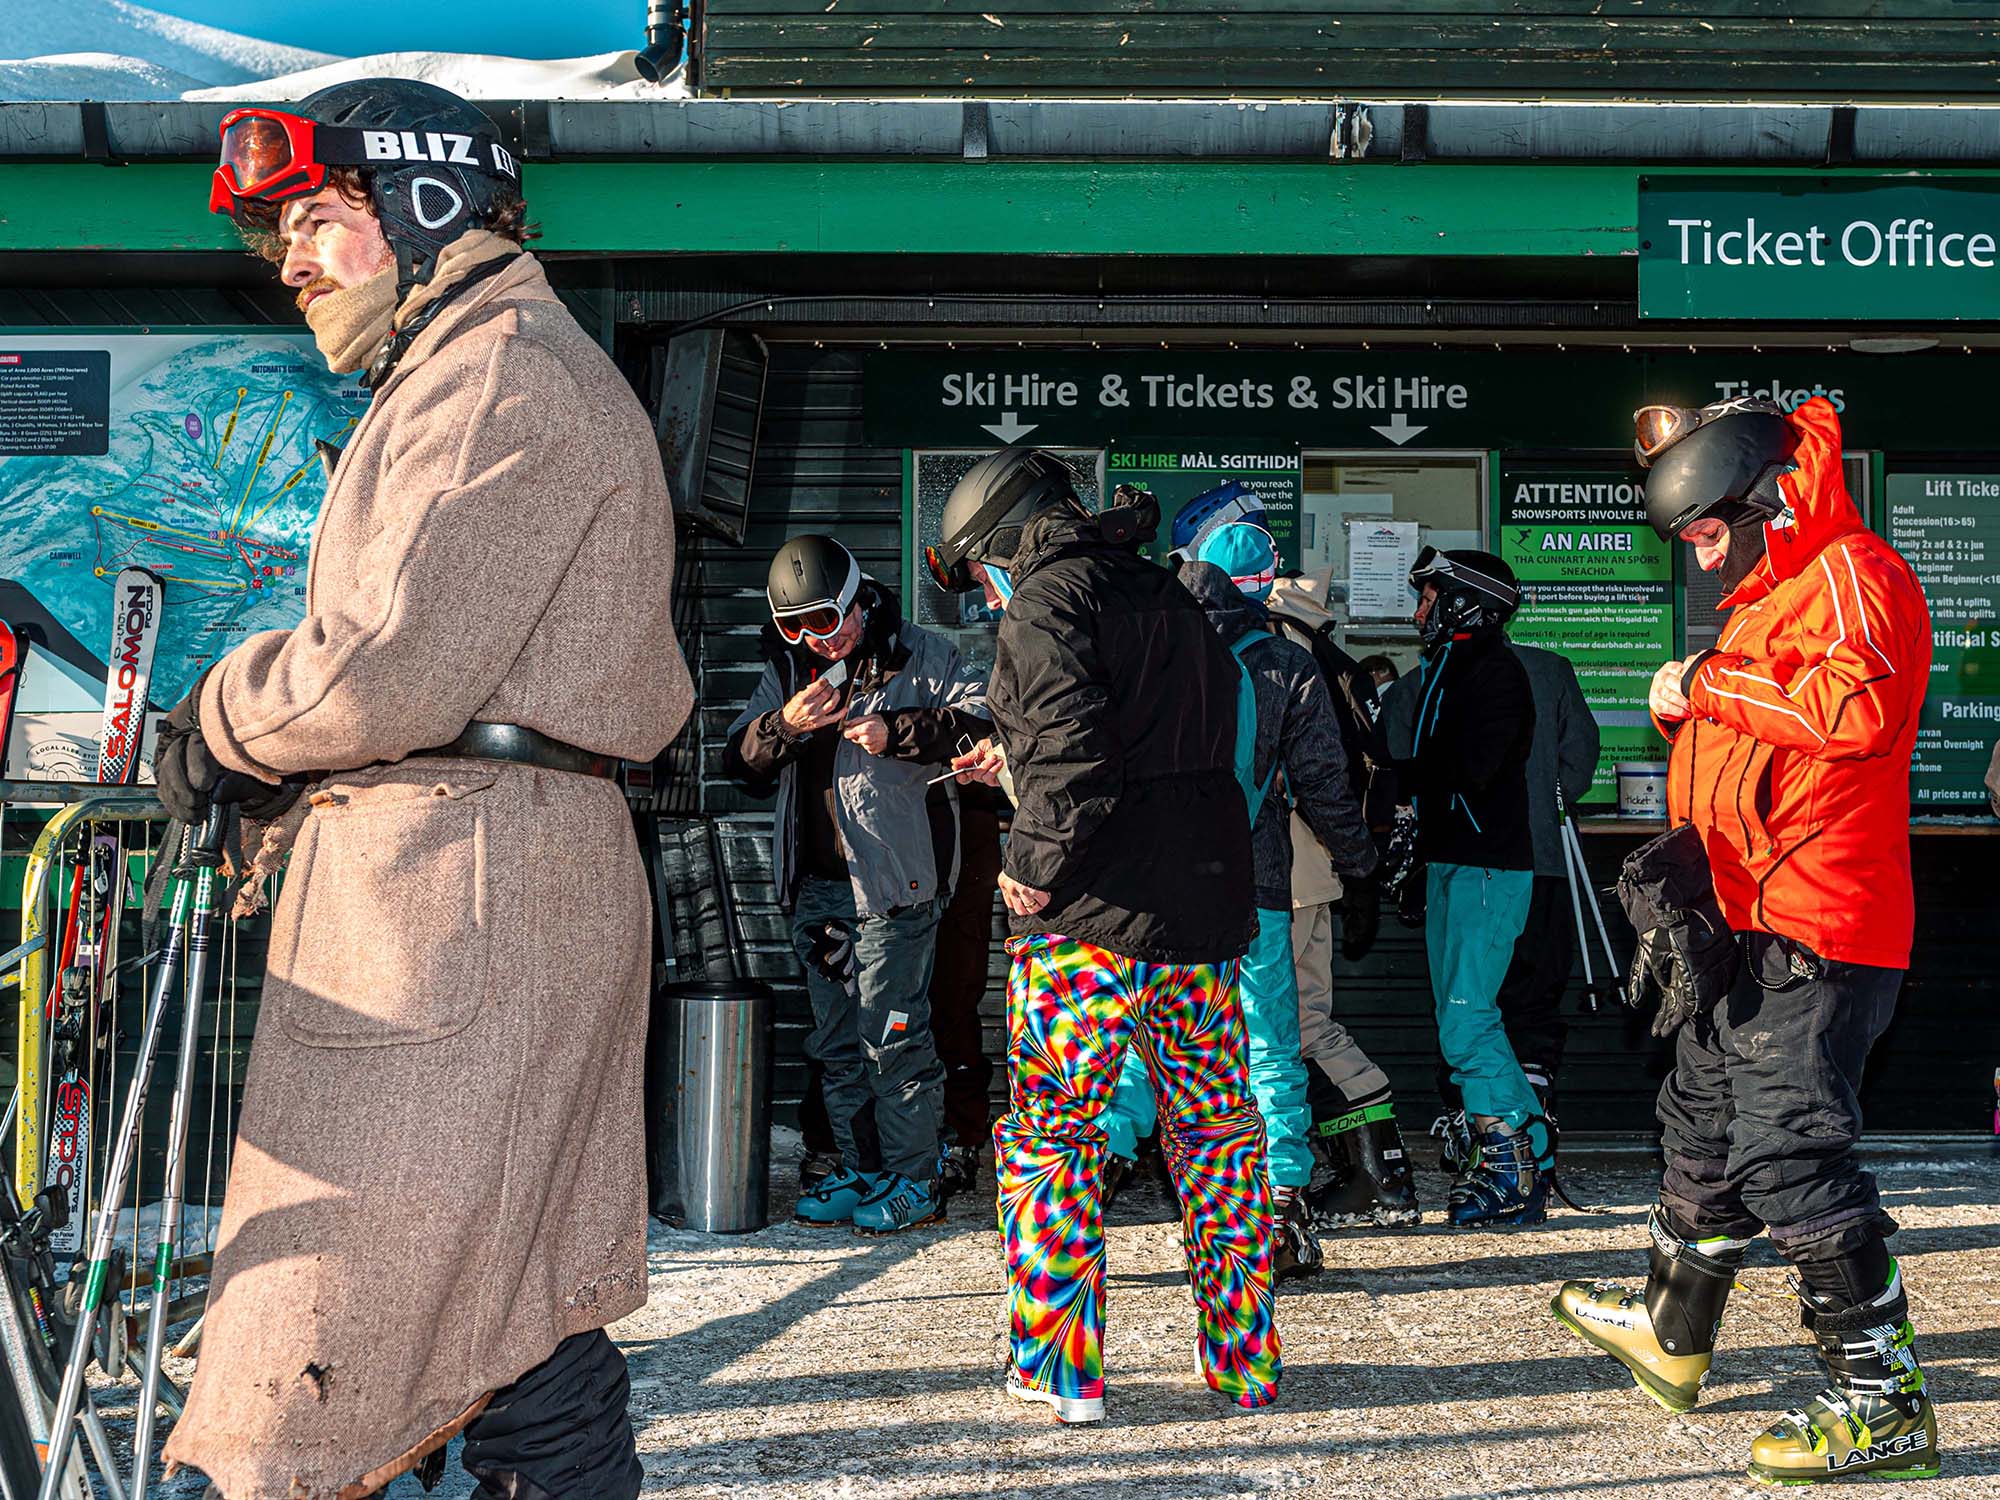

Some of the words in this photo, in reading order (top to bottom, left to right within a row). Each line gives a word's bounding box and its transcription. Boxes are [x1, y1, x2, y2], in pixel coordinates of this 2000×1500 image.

[362, 130, 479, 166] BLIZ
[1668, 218, 1826, 266] Ticket
[1841, 218, 1996, 268] Office
[942, 373, 995, 406] Ski
[1004, 374, 1078, 406] Hire
[1099, 374, 1130, 407] &
[1141, 375, 1274, 409] Tickets
[1287, 376, 1319, 409] &
[1332, 376, 1385, 409] Ski
[1395, 377, 1468, 410] Hire
[1715, 380, 1845, 413] Tickets
[1111, 453, 1136, 467] SKI
[1140, 454, 1177, 468] HIRE
[1181, 451, 1217, 468] MÀL
[1220, 455, 1299, 469] SGITHIDH
[1251, 481, 1267, 489] you
[1269, 480, 1293, 488] reach
[1925, 480, 1952, 496] Lift
[1957, 481, 2000, 496] Ticke
[1255, 490, 1277, 499] have
[1278, 490, 1293, 499] the
[1514, 483, 1646, 504] ATTENTION
[1264, 502, 1293, 510] mation
[1892, 505, 1914, 514] Adult
[1511, 509, 1586, 519] SNOWSPORTS
[1588, 510, 1634, 520] INVOLVE
[1636, 511, 1647, 520] RI
[1892, 529, 1925, 537] Student
[1541, 533, 1572, 551] AN
[1577, 533, 1633, 551] AIRE!
[1893, 540, 1920, 550] Family
[1934, 540, 1945, 549] ad
[1971, 540, 1984, 550] jun
[1514, 555, 1535, 564] THA
[1536, 555, 1584, 564] CUNNART
[1587, 555, 1608, 564] ANN
[1611, 555, 1626, 564] AN
[1903, 552, 1920, 561] mily
[1934, 552, 1945, 560] ad
[1971, 552, 1984, 562] jun
[1560, 567, 1615, 576] SNEACHDA
[1917, 563, 1954, 573] beginner
[1919, 575, 1940, 583] ssion
[1584, 594, 1609, 602] buying
[1936, 598, 1954, 606] with
[1964, 598, 1991, 608] uplifts
[145, 585, 153, 629] FOCUS
[1936, 609, 1954, 617] with
[1969, 609, 1996, 619] uplifts
[1934, 631, 1985, 648] tificial
[1930, 663, 1949, 671] nior
[106, 585, 146, 760] SALOMON
[1942, 702, 2000, 721] Parking
[1918, 729, 1941, 737] ervan
[35, 745, 60, 755] LOCAL
[1915, 740, 1941, 749] ervan
[1944, 740, 1984, 750] Overnight
[1910, 763, 1942, 772] orhome
[1918, 789, 1929, 799] All
[1932, 789, 1960, 800] prices
[1962, 791, 1977, 799] are
[56, 1083, 82, 1191] OCUS
[71, 1150, 83, 1213] SALOMON
[1826, 1429, 1928, 1472] LANGE
